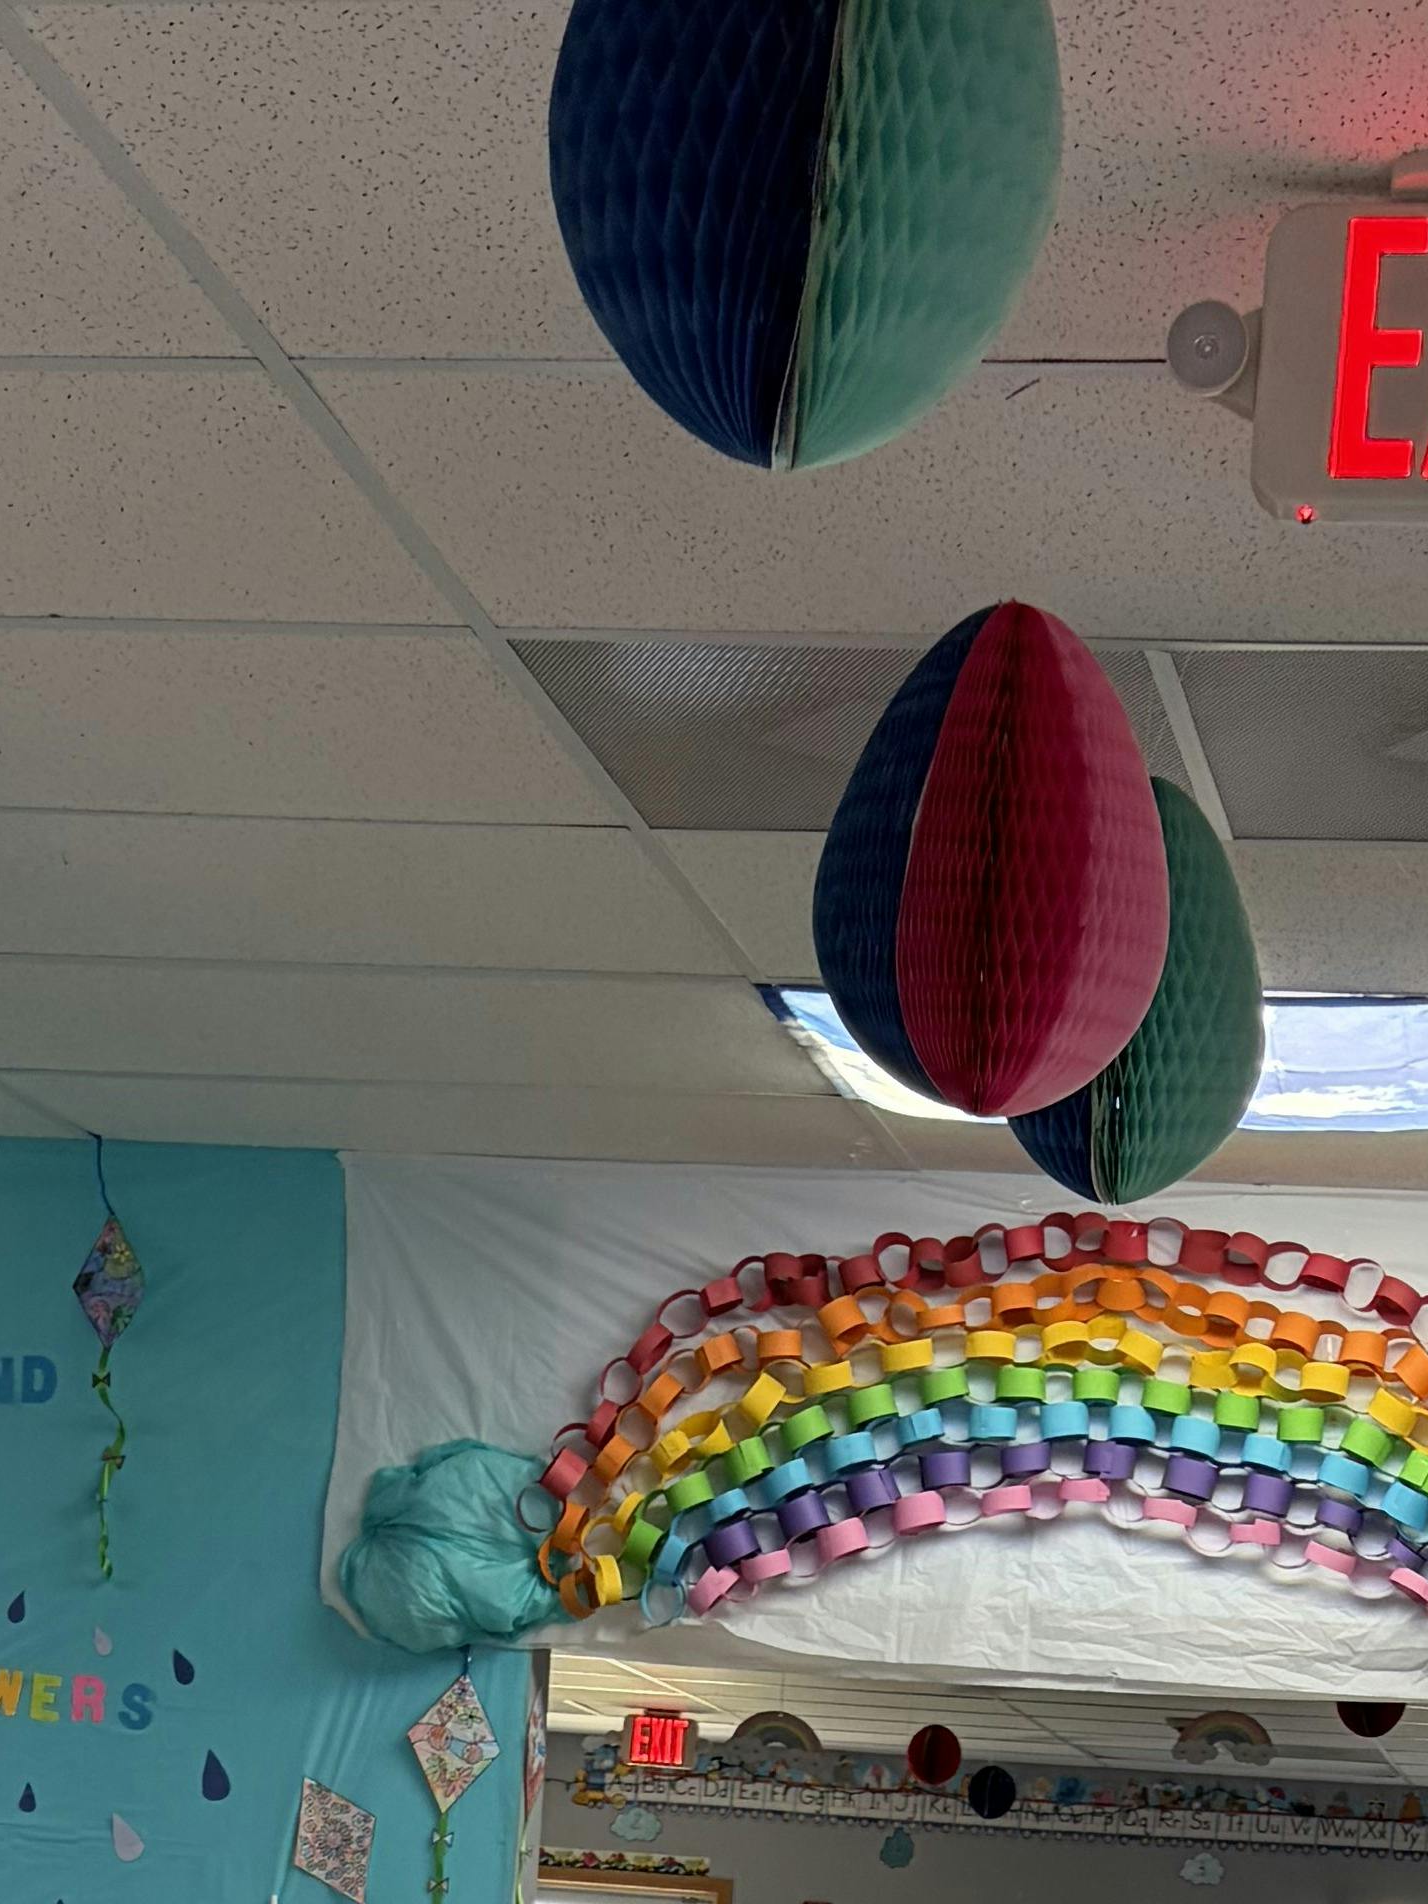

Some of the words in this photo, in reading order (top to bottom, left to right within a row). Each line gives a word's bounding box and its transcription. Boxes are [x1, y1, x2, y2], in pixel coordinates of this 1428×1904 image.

[630, 1716, 689, 1765] EXIT
[703, 1779, 727, 1798] Dd
[1189, 1813, 1211, 1832] Ss
[1256, 1815, 1280, 1836] Uu
[1291, 1817, 1312, 1836] Vv
[1321, 1817, 1357, 1838] Ww
[1361, 1821, 1387, 1841] Xx
[1400, 1823, 1420, 1849] Yy
